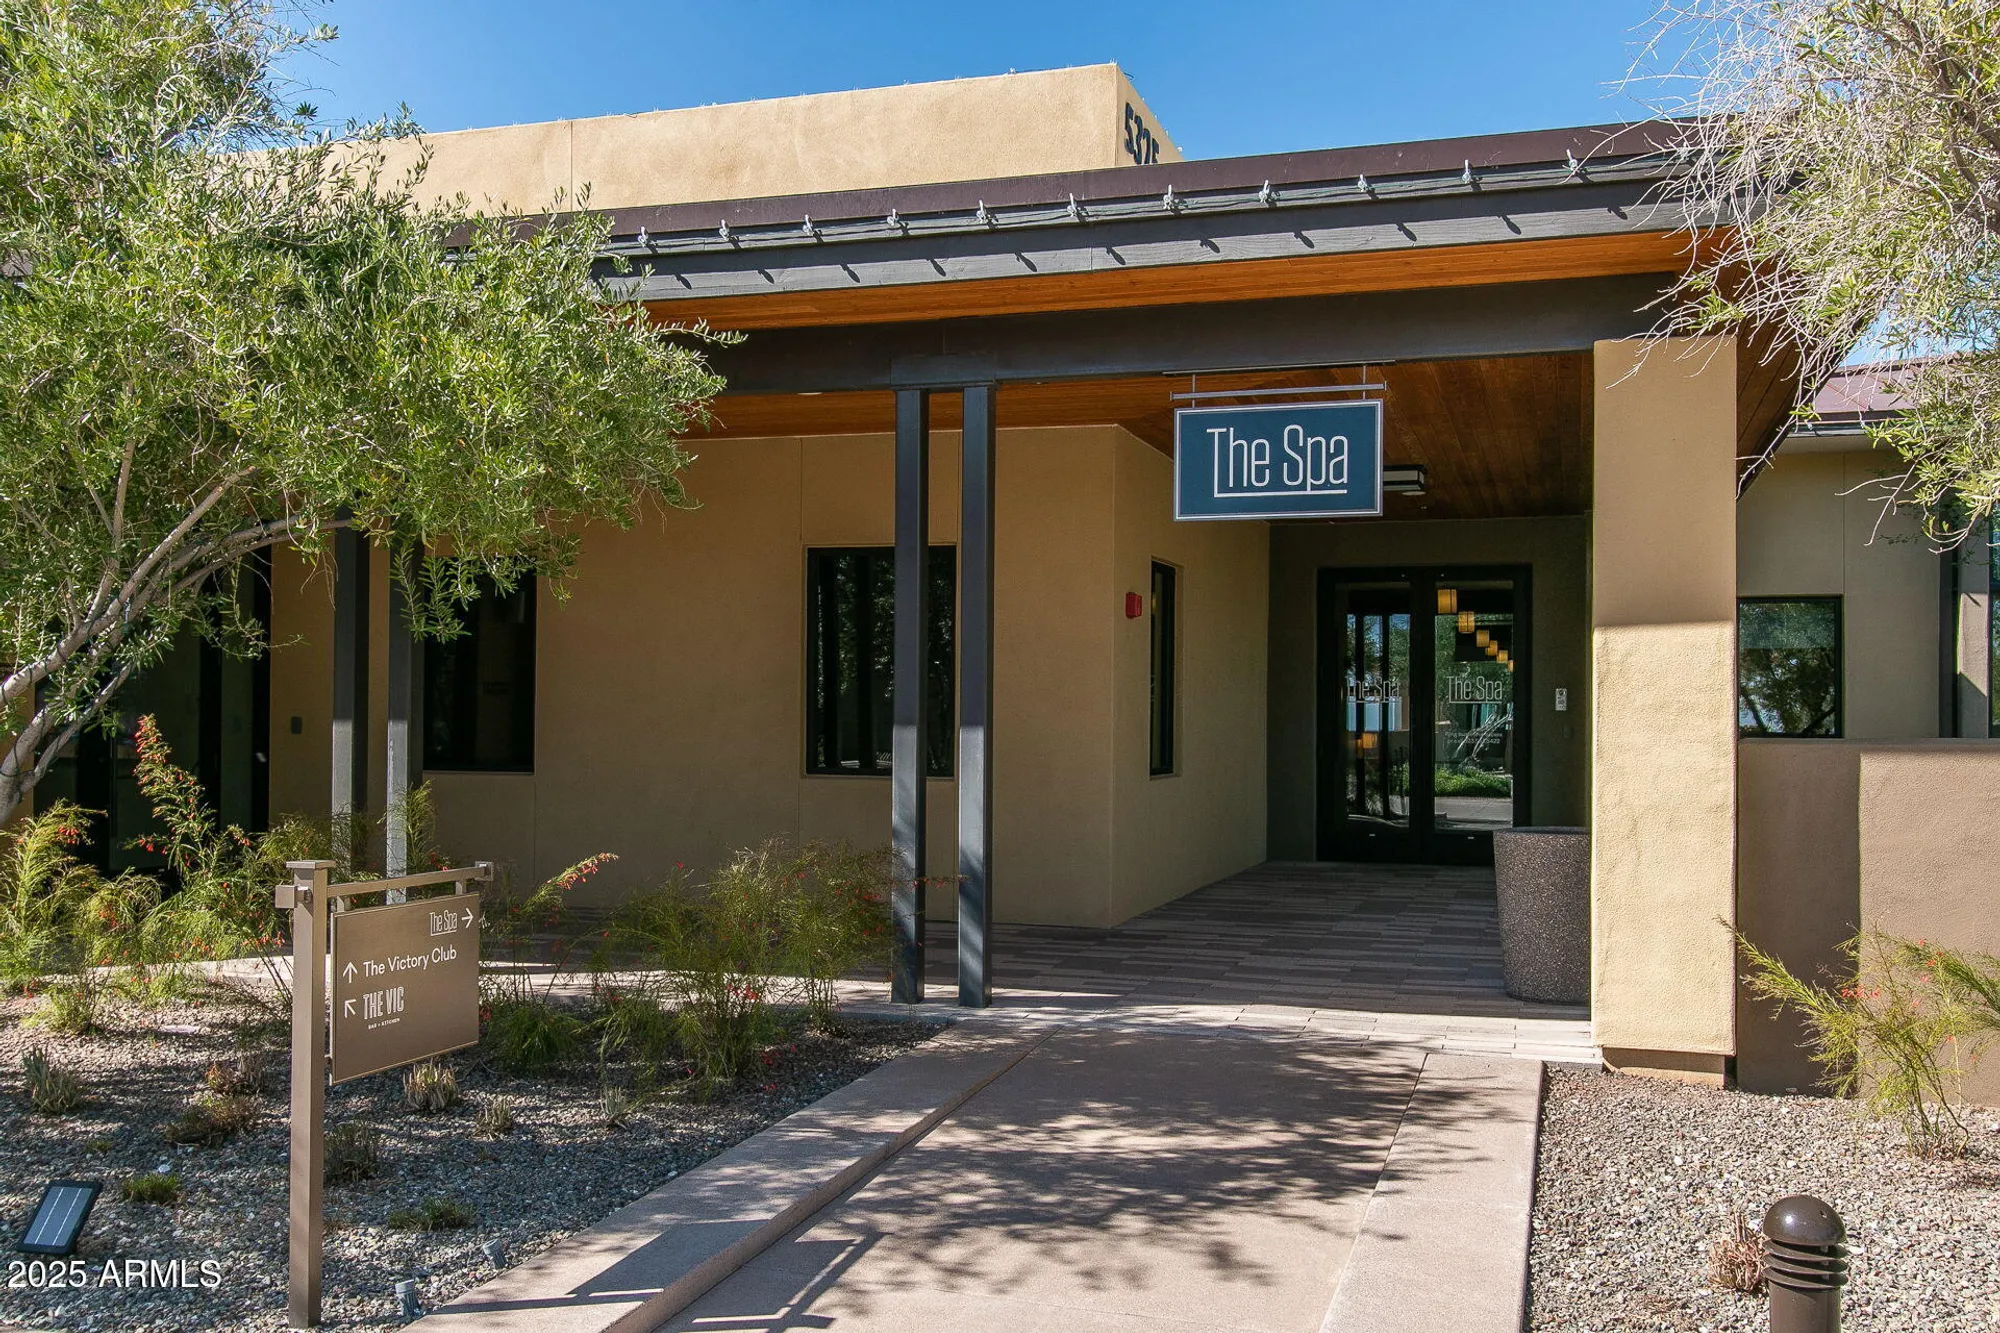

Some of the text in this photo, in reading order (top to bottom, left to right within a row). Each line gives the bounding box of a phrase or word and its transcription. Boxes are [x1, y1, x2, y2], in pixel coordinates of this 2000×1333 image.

[1206, 424, 1348, 498] The Spa
[1446, 675, 1502, 703] The Spa
[430, 909, 457, 936] The Spa
[363, 945, 457, 977] The Victory Club
[363, 986, 405, 1020] THE VIC
